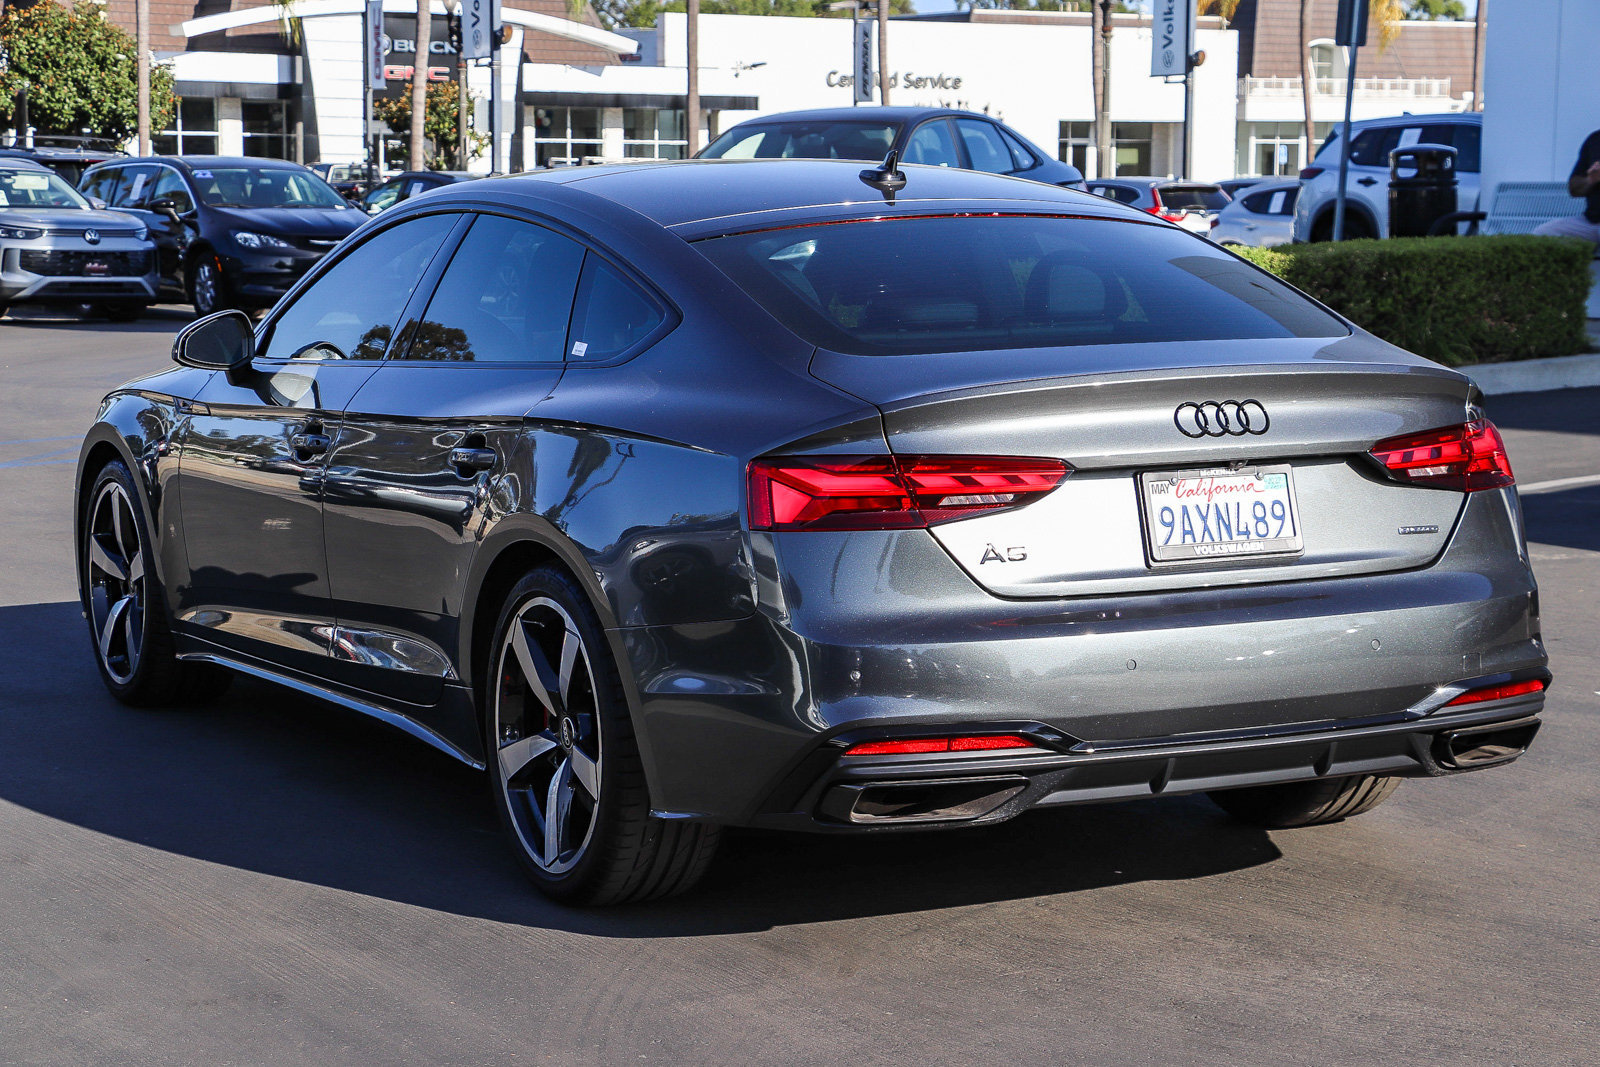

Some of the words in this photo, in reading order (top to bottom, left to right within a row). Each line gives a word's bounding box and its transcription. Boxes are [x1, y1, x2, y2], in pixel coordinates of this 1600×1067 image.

[393, 39, 457, 54] BCK
[903, 72, 962, 89] Service
[1151, 483, 1170, 495] MAY
[1175, 478, 1264, 502] California
[1160, 500, 1285, 545] 9AXN489
[980, 542, 1027, 564] A5
[1193, 541, 1264, 556] VOLKSWAGEN
